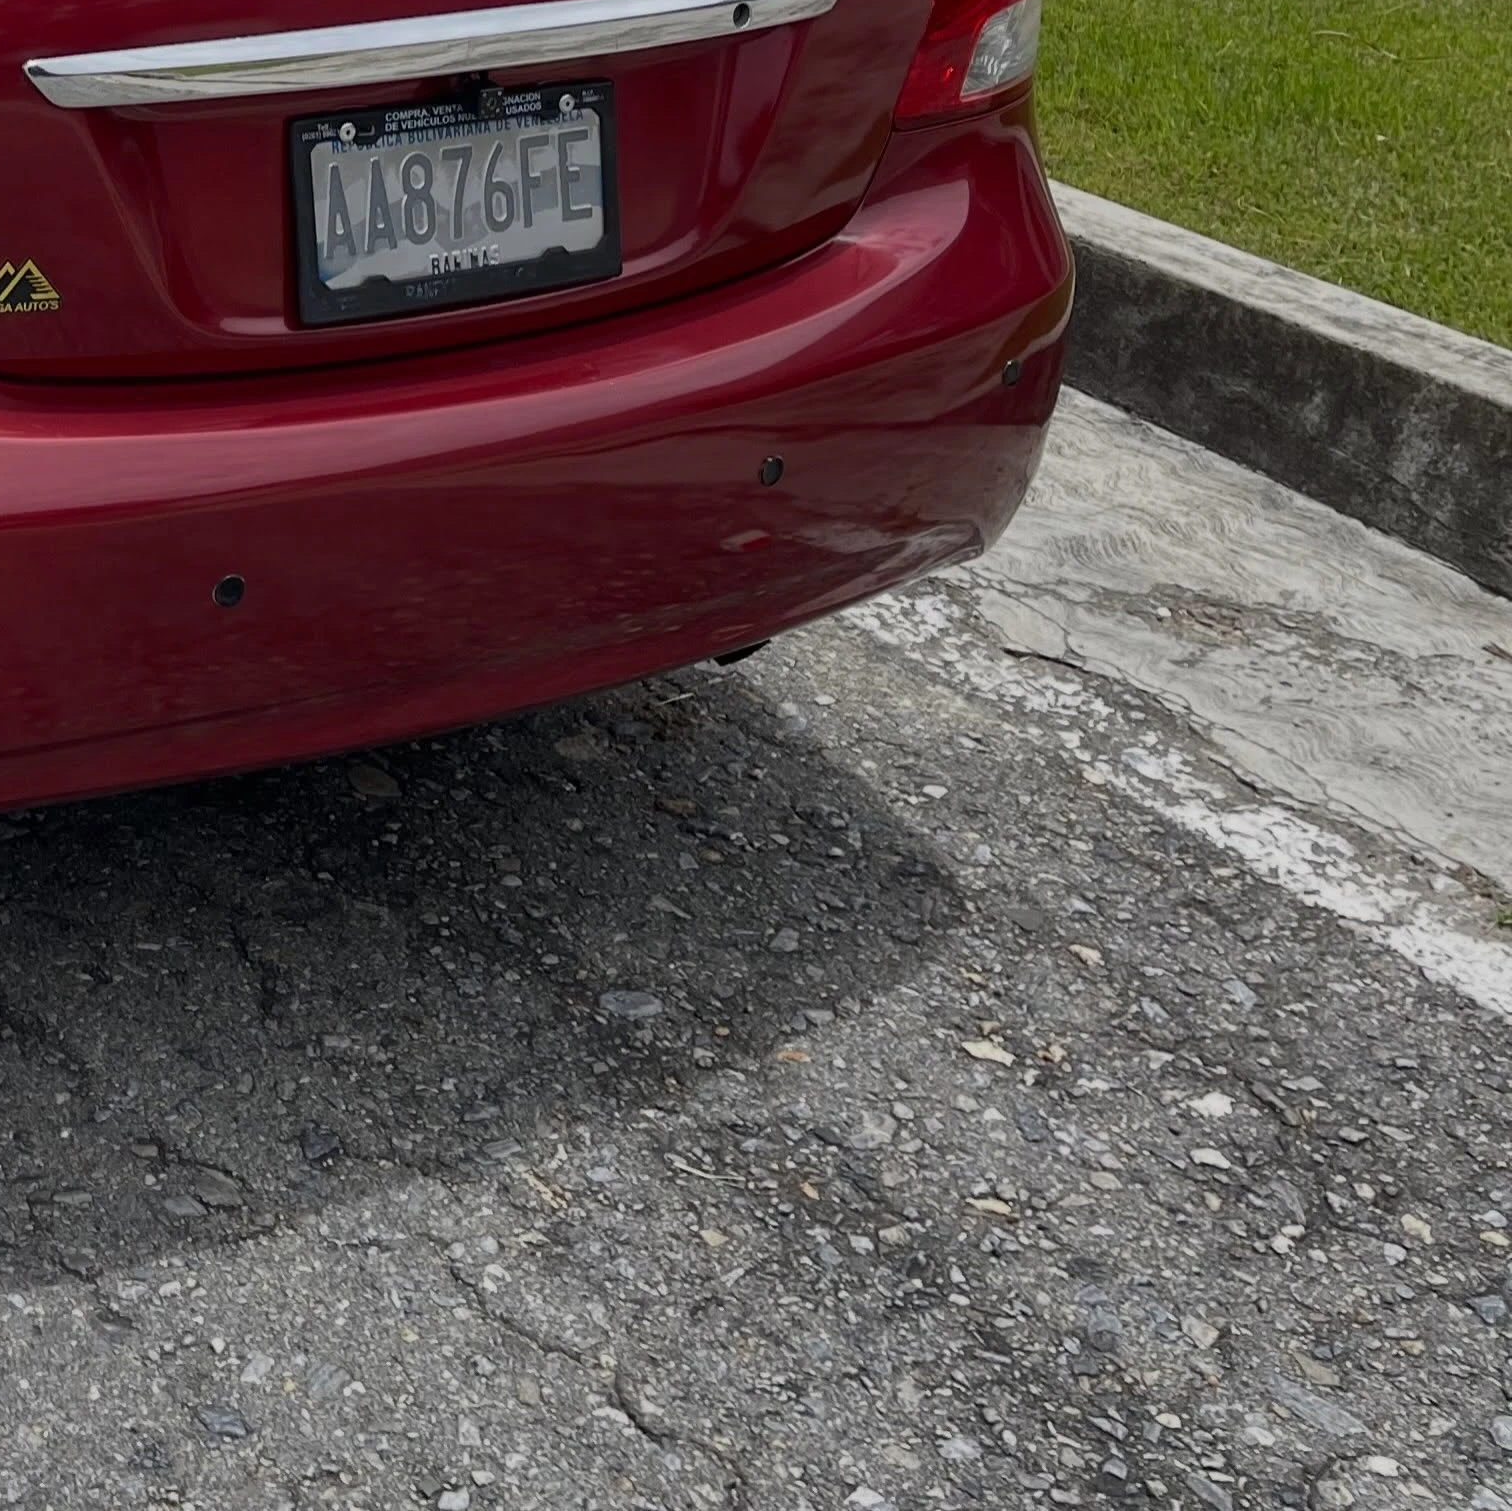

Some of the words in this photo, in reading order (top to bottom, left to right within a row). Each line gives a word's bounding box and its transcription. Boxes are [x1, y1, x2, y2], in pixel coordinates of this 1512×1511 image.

[385, 121, 399, 132] DE
[505, 101, 542, 115] USADOS
[432, 103, 463, 116] VENTA
[496, 117, 511, 131] DE
[324, 128, 594, 260] AA876FE
[14, 300, 59, 313] AUTO'S
